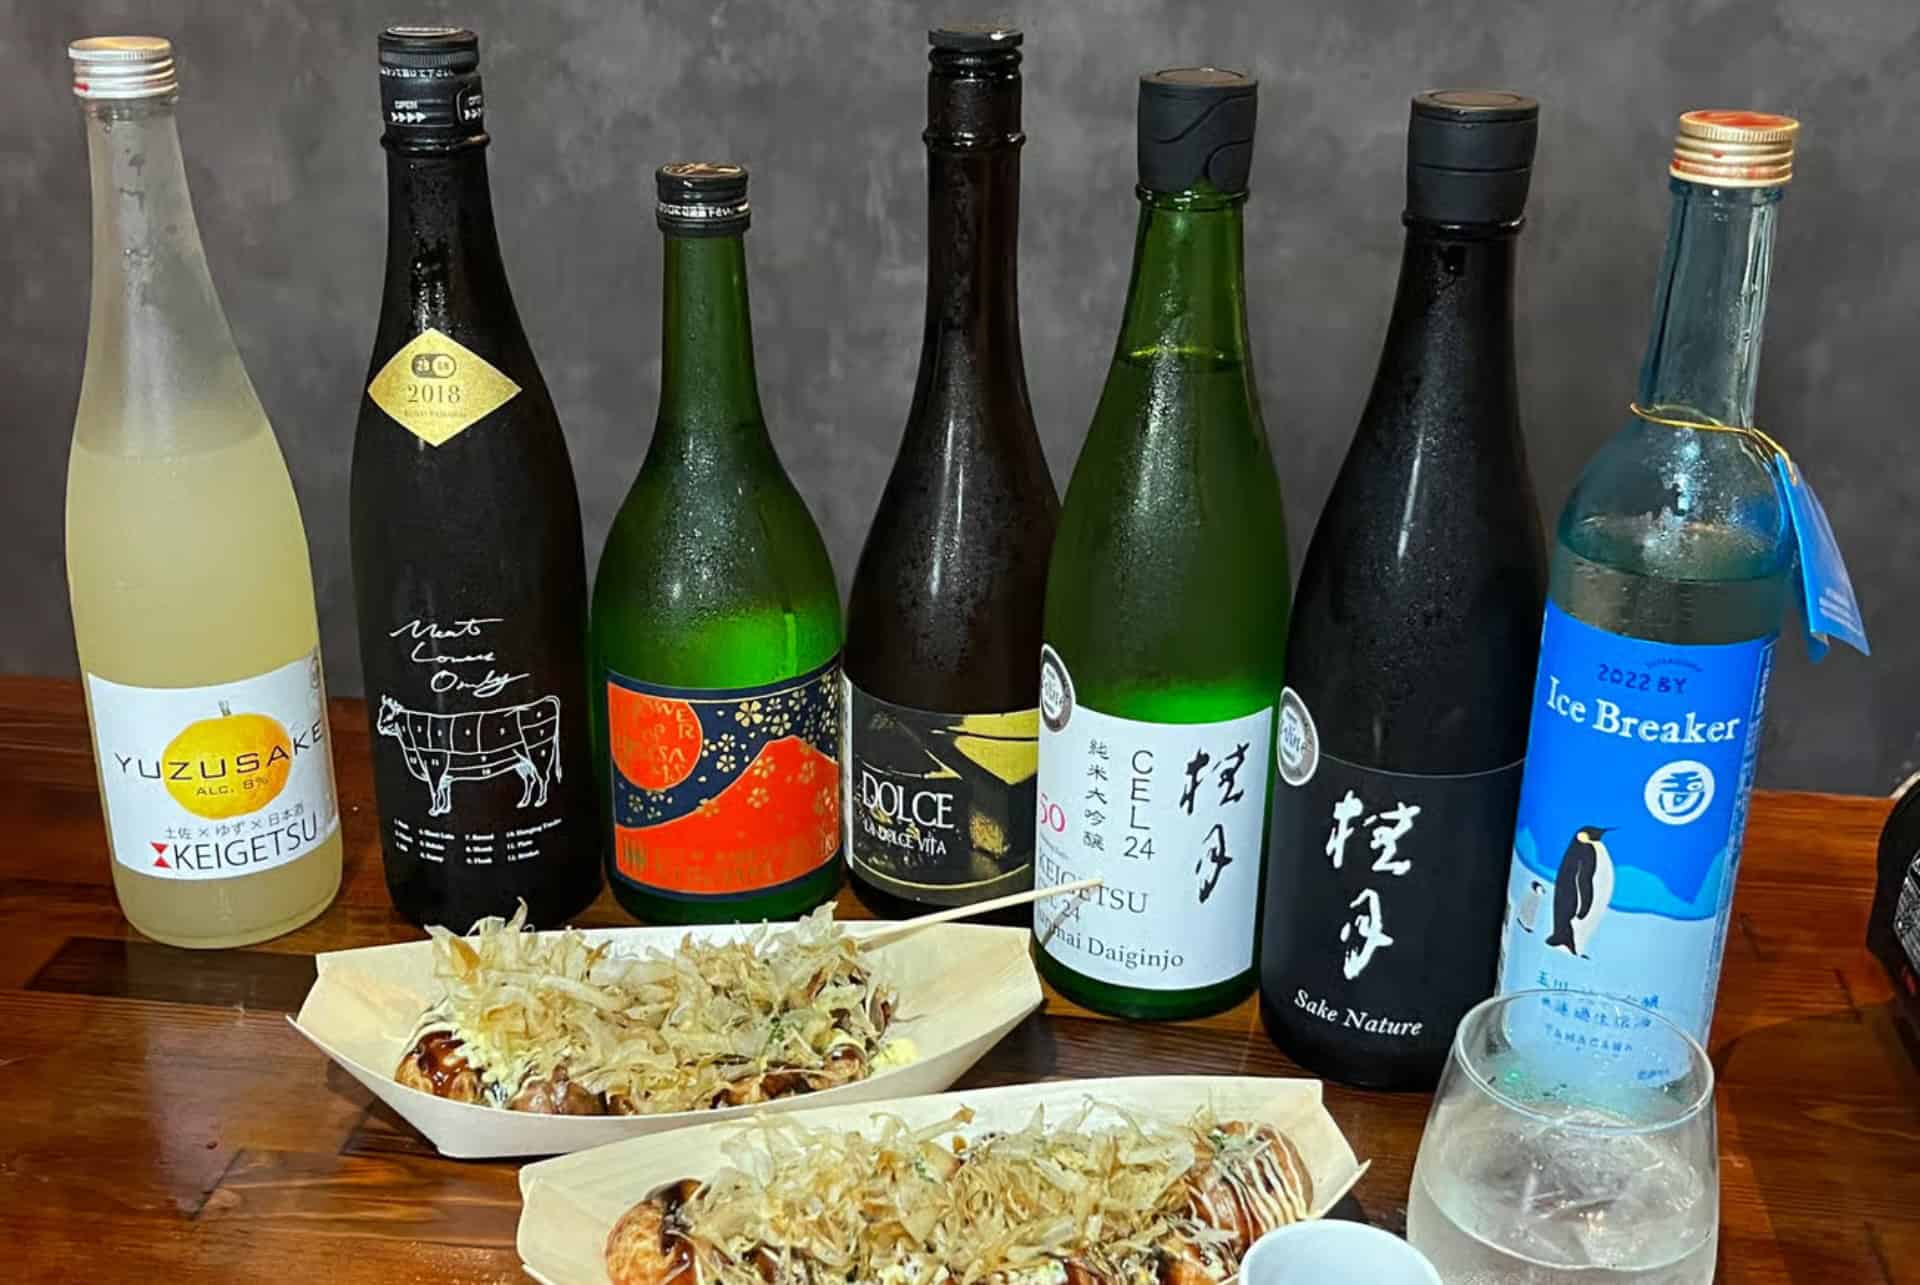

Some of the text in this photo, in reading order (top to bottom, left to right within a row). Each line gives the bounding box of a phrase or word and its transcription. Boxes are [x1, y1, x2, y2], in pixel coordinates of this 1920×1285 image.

[407, 384, 461, 403] 2018
[1598, 663, 1651, 691] 2022
[1657, 676, 1688, 694] BY
[1547, 674, 1741, 744] Ice Breaker
[114, 719, 322, 782] YUZUSAKE
[196, 785, 235, 797] ALC.
[862, 770, 955, 829] DOLCE
[1123, 749, 1156, 861] CEL 24
[174, 812, 318, 871] KEIGETSU
[1088, 936, 1185, 973] Daiginjo
[1293, 988, 1426, 1037] Sake Nature
